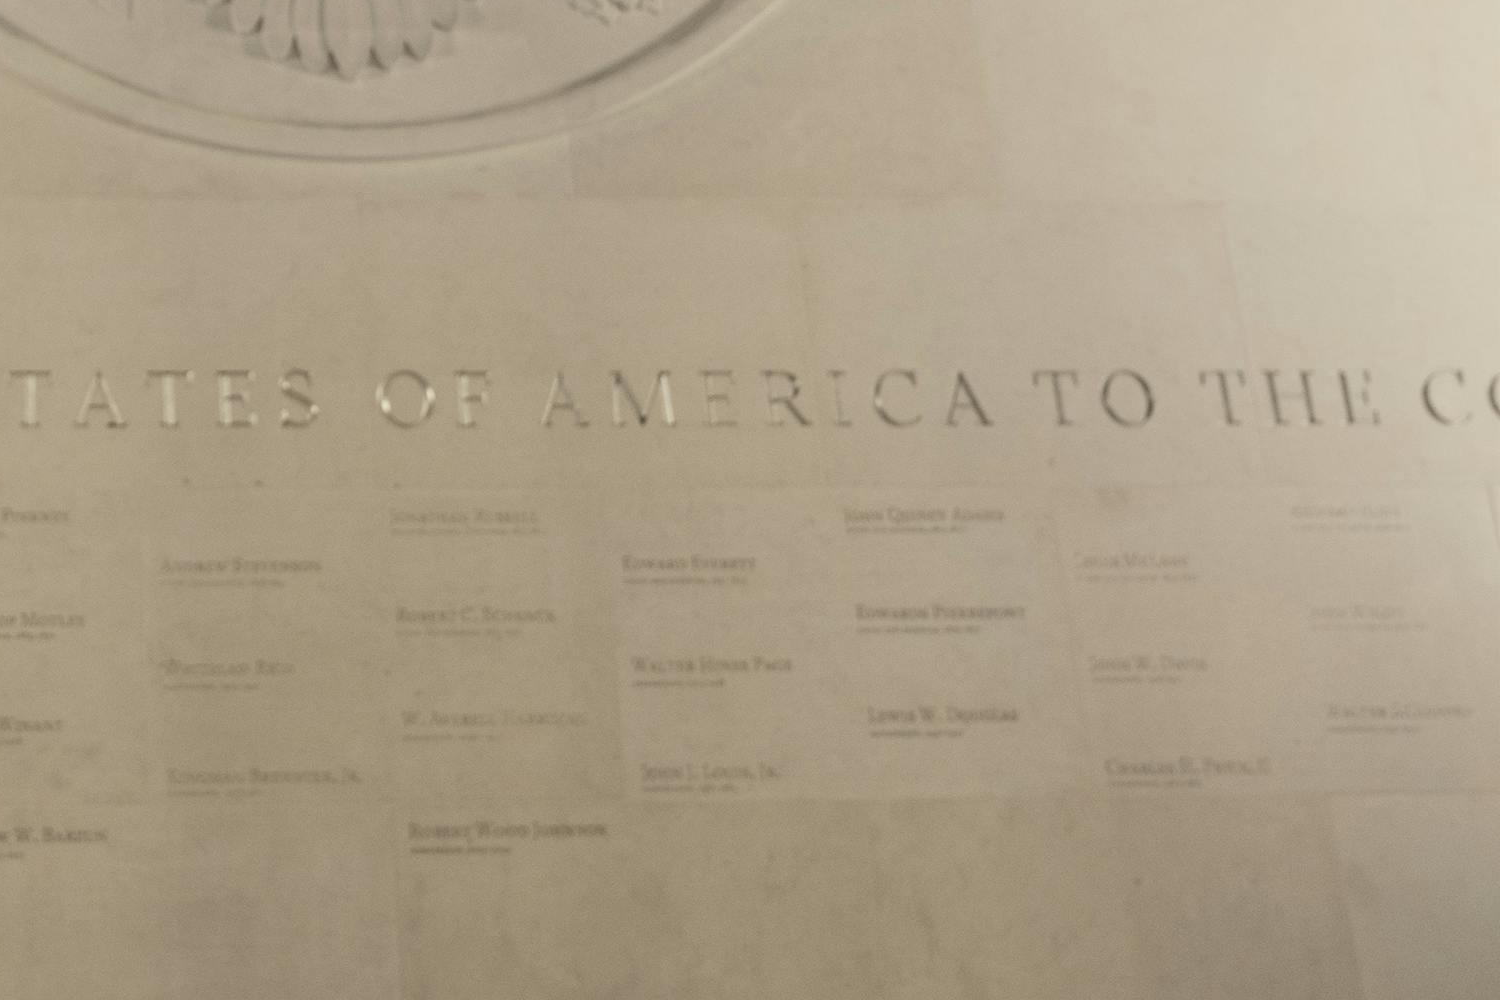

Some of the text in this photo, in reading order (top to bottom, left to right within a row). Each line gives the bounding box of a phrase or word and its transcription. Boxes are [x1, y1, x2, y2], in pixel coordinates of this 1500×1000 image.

[376, 369, 492, 429] OF
[541, 369, 994, 429] AMERICA
[1031, 369, 1156, 428] TO
[1199, 369, 1382, 428] THE
